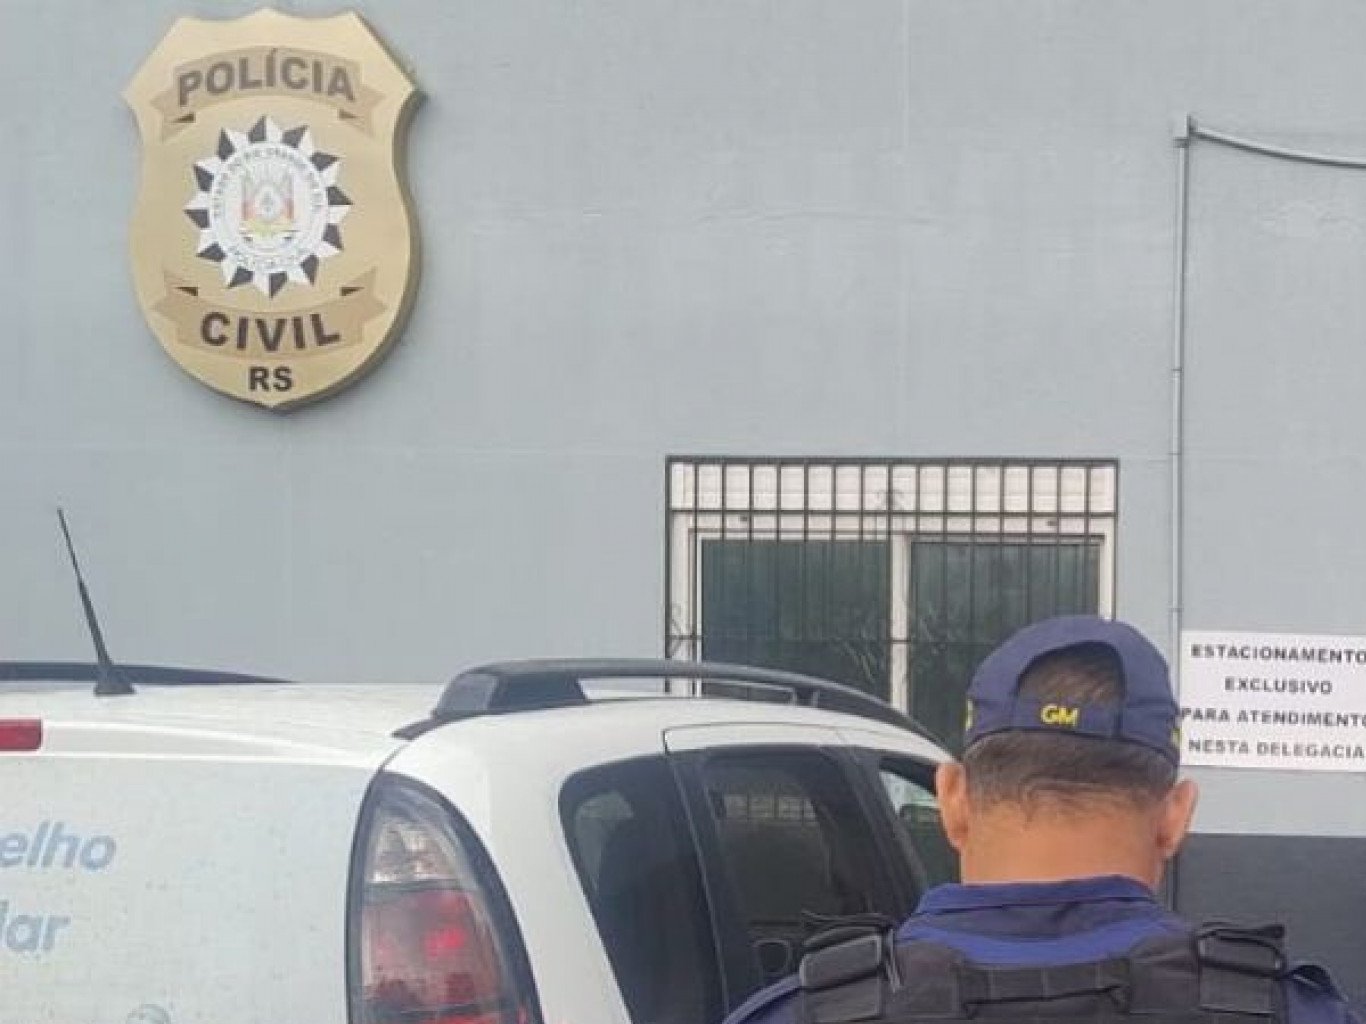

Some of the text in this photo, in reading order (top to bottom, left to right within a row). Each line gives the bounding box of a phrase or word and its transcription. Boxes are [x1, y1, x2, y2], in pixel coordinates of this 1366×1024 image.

[178, 48, 356, 107] POLÍCIA
[199, 311, 341, 351] CIVIL
[248, 366, 294, 392] RS
[1224, 676, 1333, 695] EXCLUSIVO
[1040, 704, 1081, 727] GM
[1181, 707, 1230, 723] PARA
[1188, 738, 1366, 759] NESTA DELEGACIA
